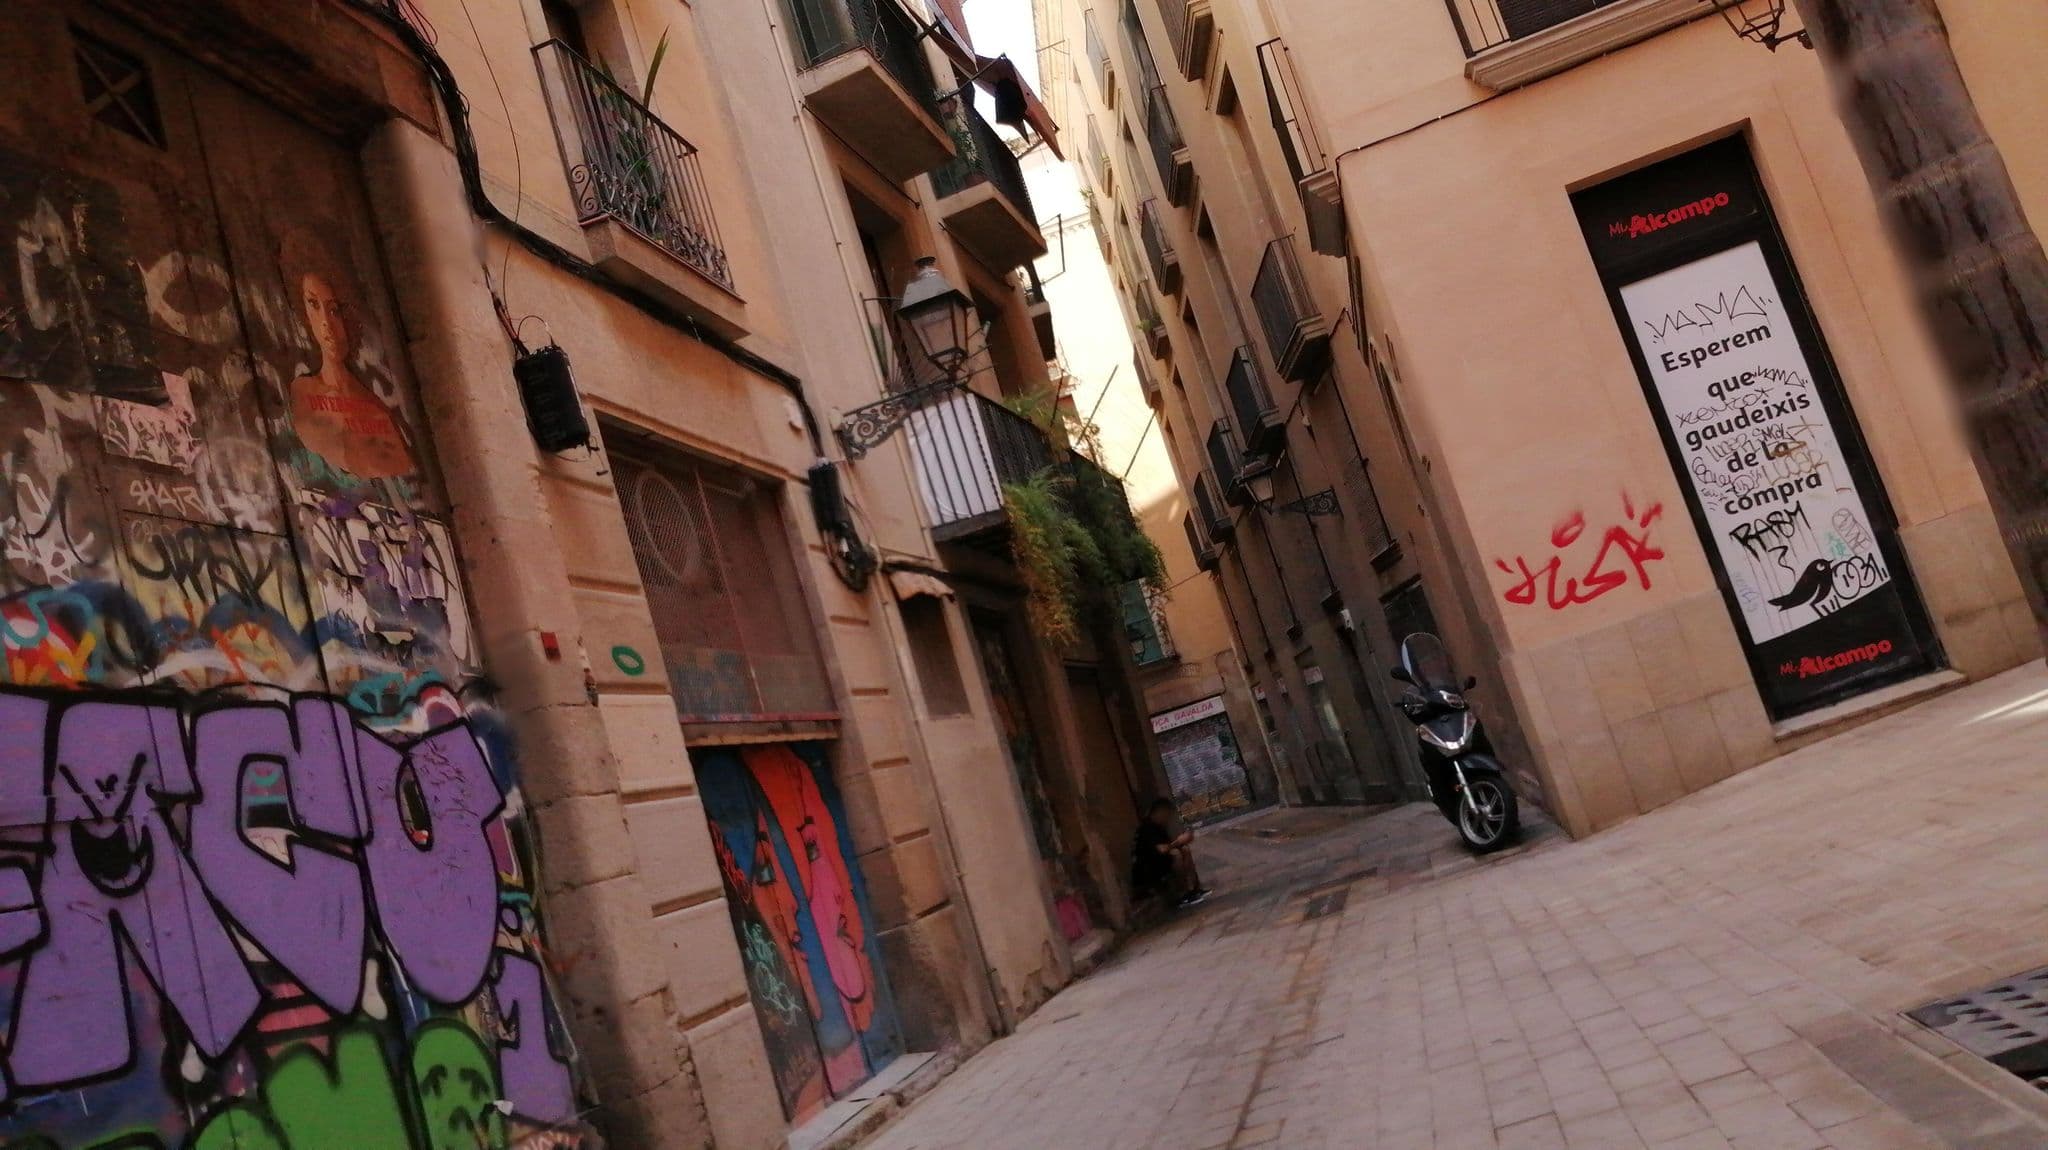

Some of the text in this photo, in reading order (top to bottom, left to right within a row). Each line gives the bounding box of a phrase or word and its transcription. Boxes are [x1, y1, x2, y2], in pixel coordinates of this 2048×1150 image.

[1629, 192, 1729, 239] Alcampo
[1660, 324, 1773, 373] Esperem
[1707, 371, 1756, 403] que
[1686, 392, 1811, 452] gaudeixis
[1726, 440, 1790, 474] de la
[1724, 472, 1823, 515] compra
[1799, 639, 1893, 679] Alcampo
